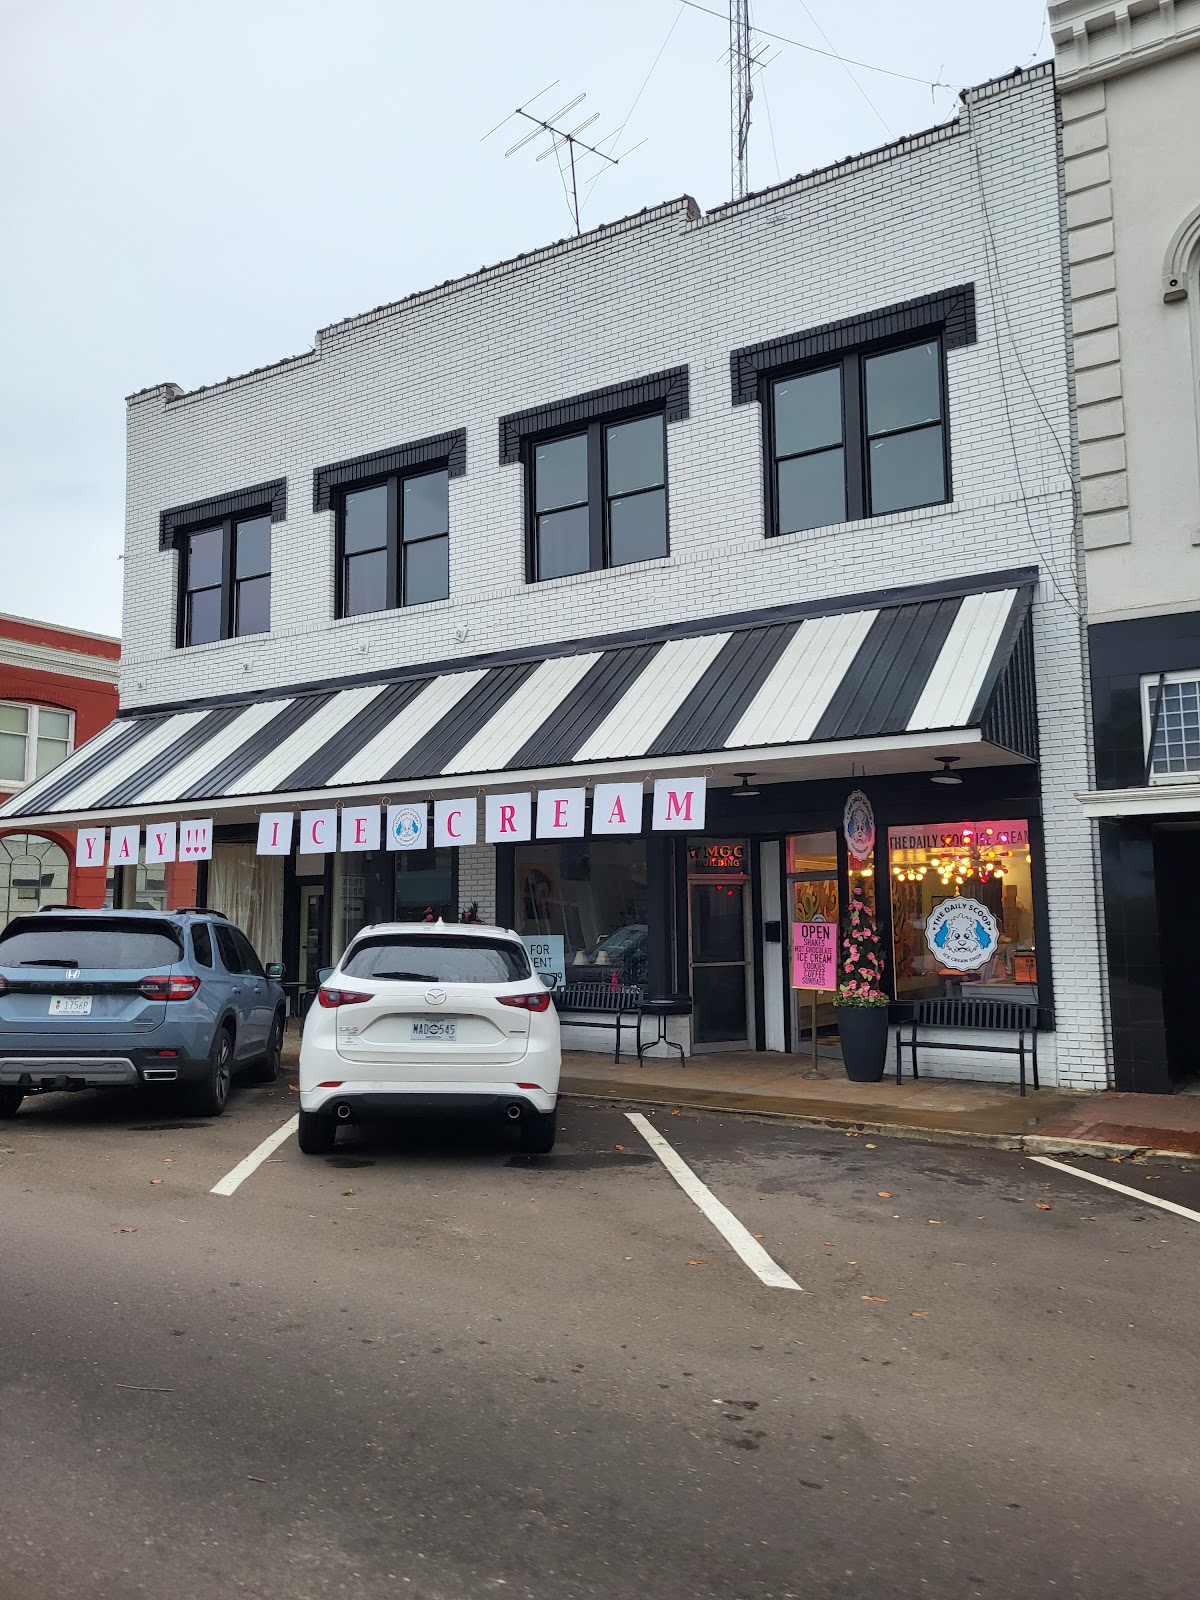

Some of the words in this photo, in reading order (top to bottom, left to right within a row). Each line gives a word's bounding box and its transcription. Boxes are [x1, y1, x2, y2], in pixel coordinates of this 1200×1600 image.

[271, 818, 367, 847] ICE
[447, 791, 694, 838] CREAM
[889, 836, 908, 850] THE
[909, 834, 938, 849] DAILY
[933, 911, 945, 926] THE
[944, 903, 967, 914] DAILY
[968, 904, 991, 926] SCOOP
[801, 924, 830, 939] OPEN
[803, 938, 825, 947] SHAKES
[530, 944, 550, 955] FOR
[805, 946, 832, 955] CHOCOLATE
[532, 957, 553, 968] ENT
[797, 952, 808, 962] ICE
[809, 953, 832, 964] CREAM
[803, 961, 826, 971] COOKIES
[803, 969, 826, 979] COFFEE
[801, 977, 826, 986] SUNDAES
[64, 1000, 89, 1010] 1756P
[439, 1024, 455, 1035] 545
